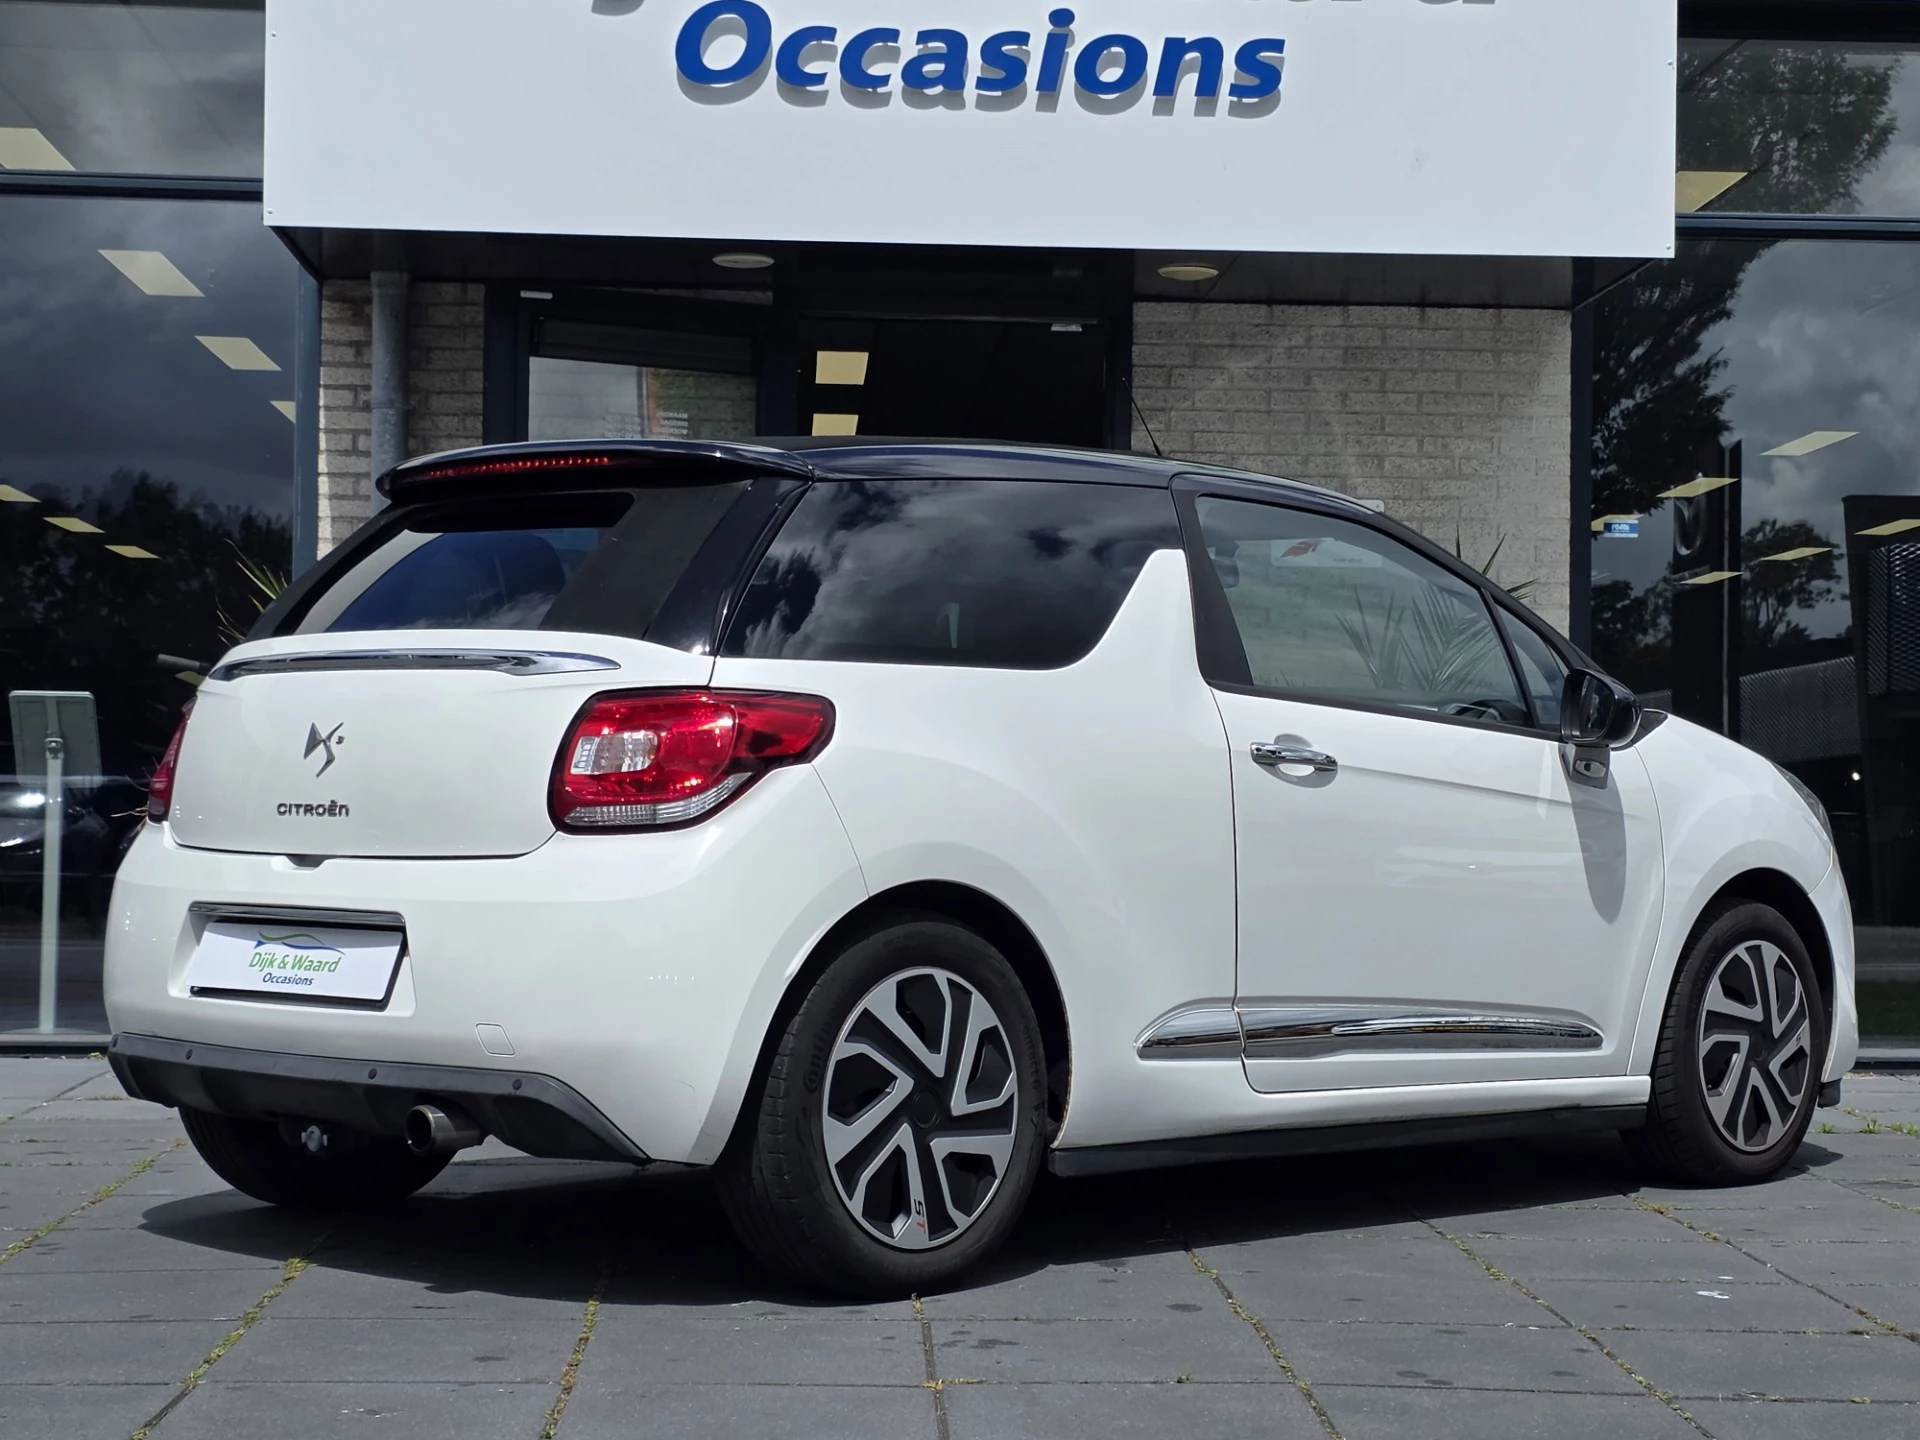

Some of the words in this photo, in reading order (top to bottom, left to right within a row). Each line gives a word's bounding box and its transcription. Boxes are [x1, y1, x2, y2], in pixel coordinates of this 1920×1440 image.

[675, 0, 1286, 99] Occasions
[249, 952, 277, 972] Dijk
[278, 954, 290, 969] &
[291, 954, 342, 972] Waard
[262, 972, 314, 985] Occasions
